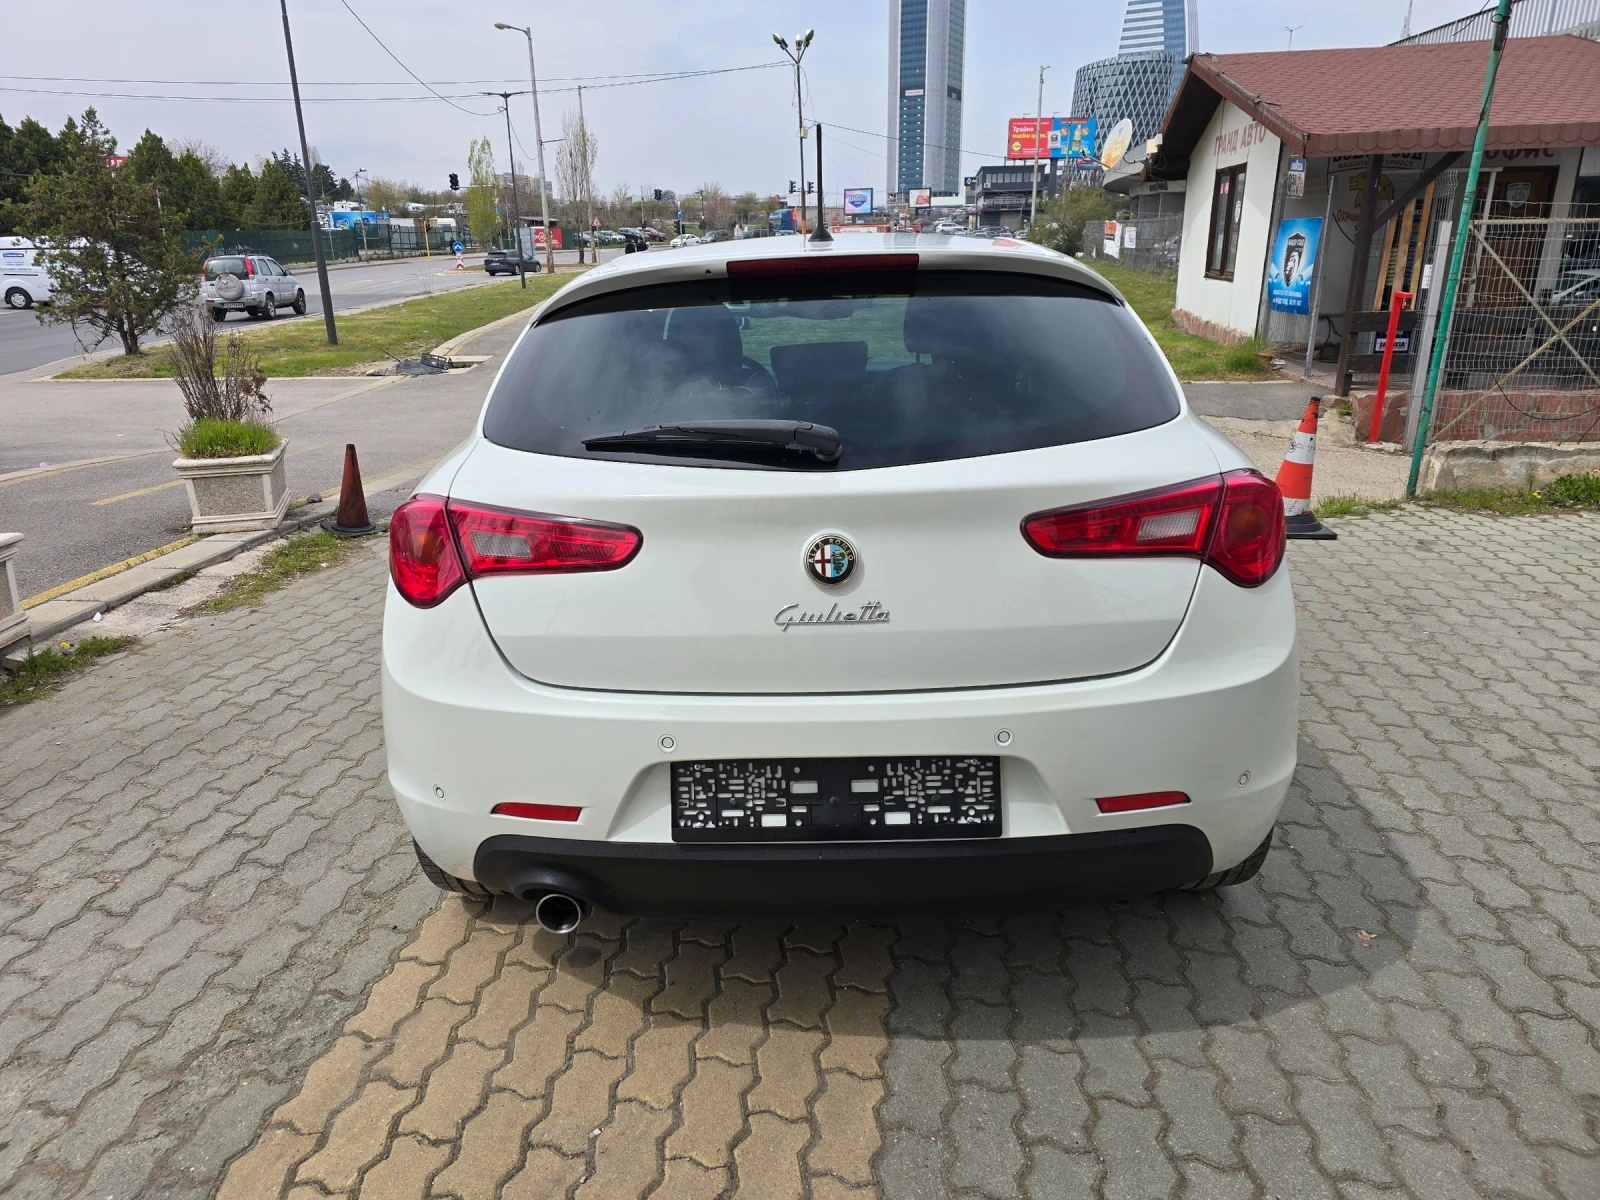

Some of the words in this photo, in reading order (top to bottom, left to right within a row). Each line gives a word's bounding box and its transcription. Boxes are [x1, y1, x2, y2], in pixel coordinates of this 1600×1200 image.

[1214, 128, 1239, 156] ГРАНД
[1240, 122, 1267, 150] АВТО
[808, 541, 824, 564] ALFA
[828, 538, 853, 562] ROMEO
[774, 600, 890, 633] Giulietta
